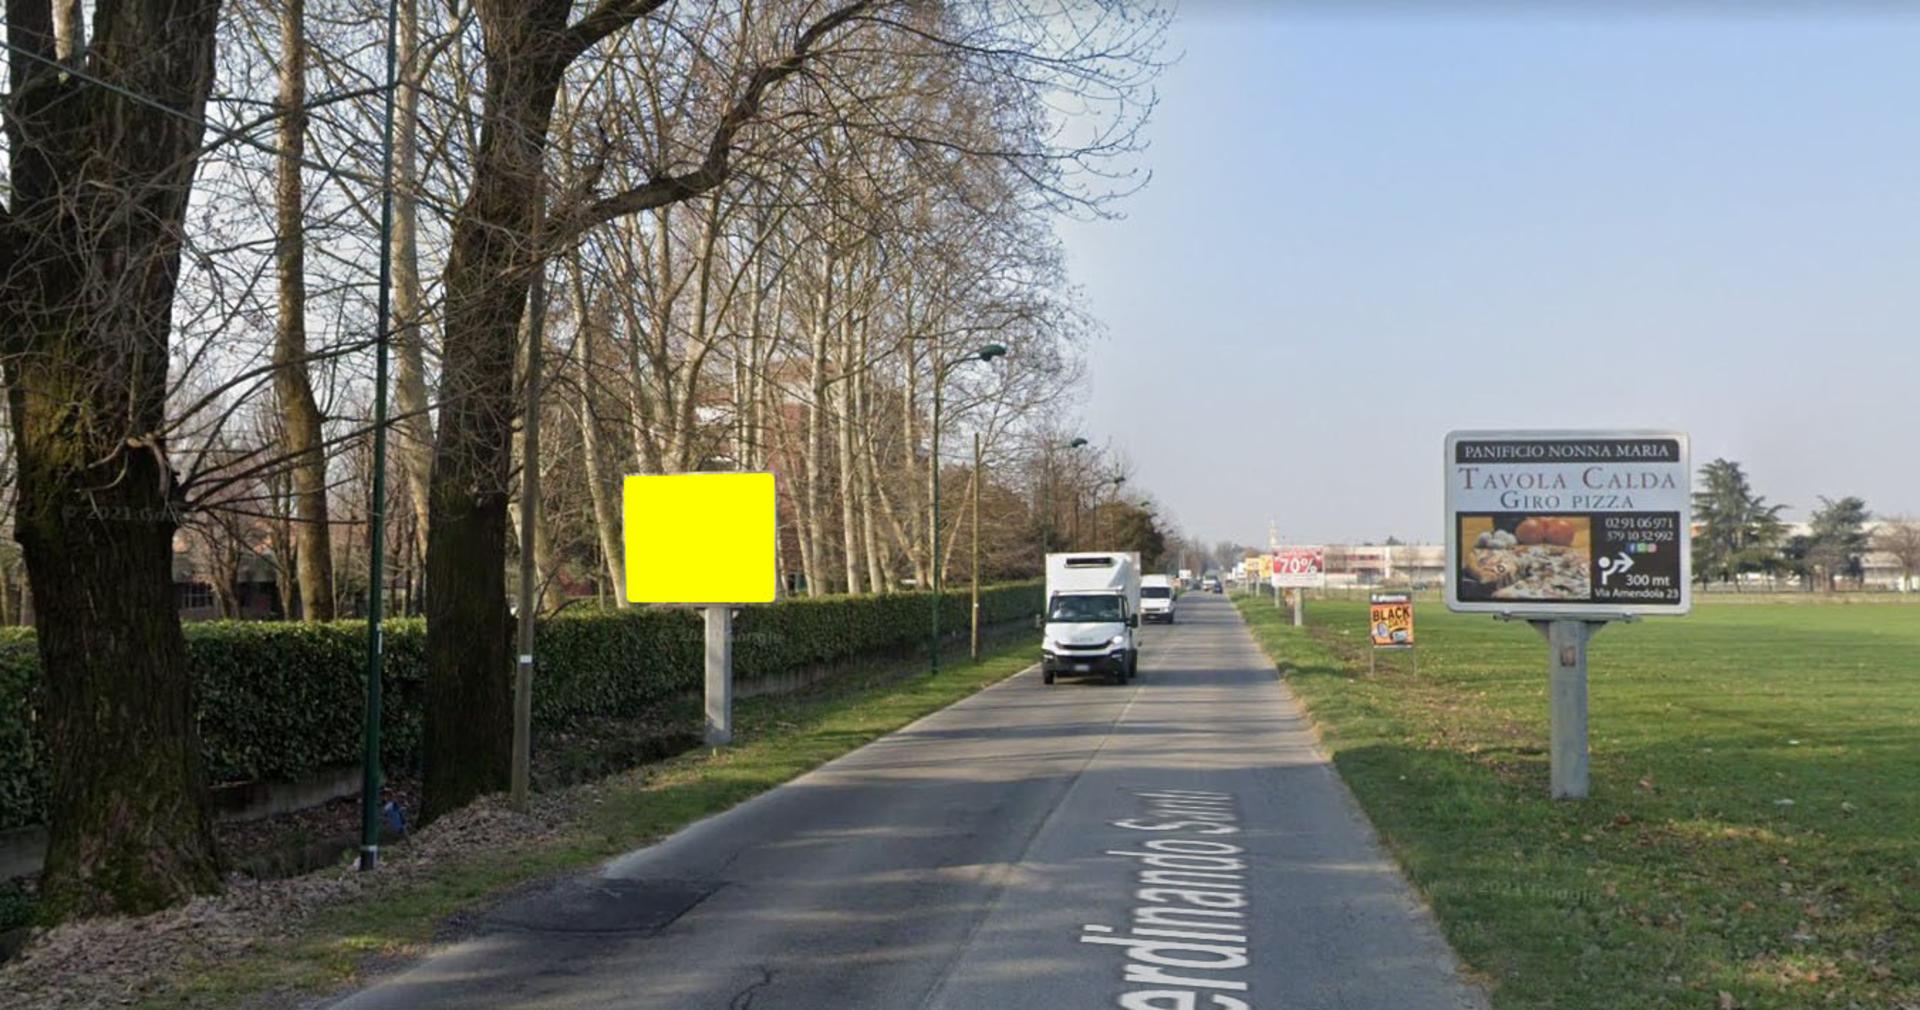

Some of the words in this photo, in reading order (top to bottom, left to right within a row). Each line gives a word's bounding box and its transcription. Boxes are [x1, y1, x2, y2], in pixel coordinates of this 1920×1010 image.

[1464, 445, 1545, 458] PANIFICIO
[1548, 444, 1612, 458] NONNA
[1616, 444, 1670, 457] MARIA
[1458, 467, 1567, 489] TAVOLA
[1582, 466, 1676, 489] CALDA
[1500, 490, 1560, 509] GIRO
[1571, 494, 1634, 509] PIZZA
[1281, 558, 1318, 574] 70%
[1626, 574, 1649, 586] 300
[1652, 575, 1670, 586] mt
[1595, 588, 1611, 598] Via
[1612, 588, 1664, 598] Amendola
[1666, 588, 1679, 599] 23
[1372, 606, 1410, 621] BLACK
